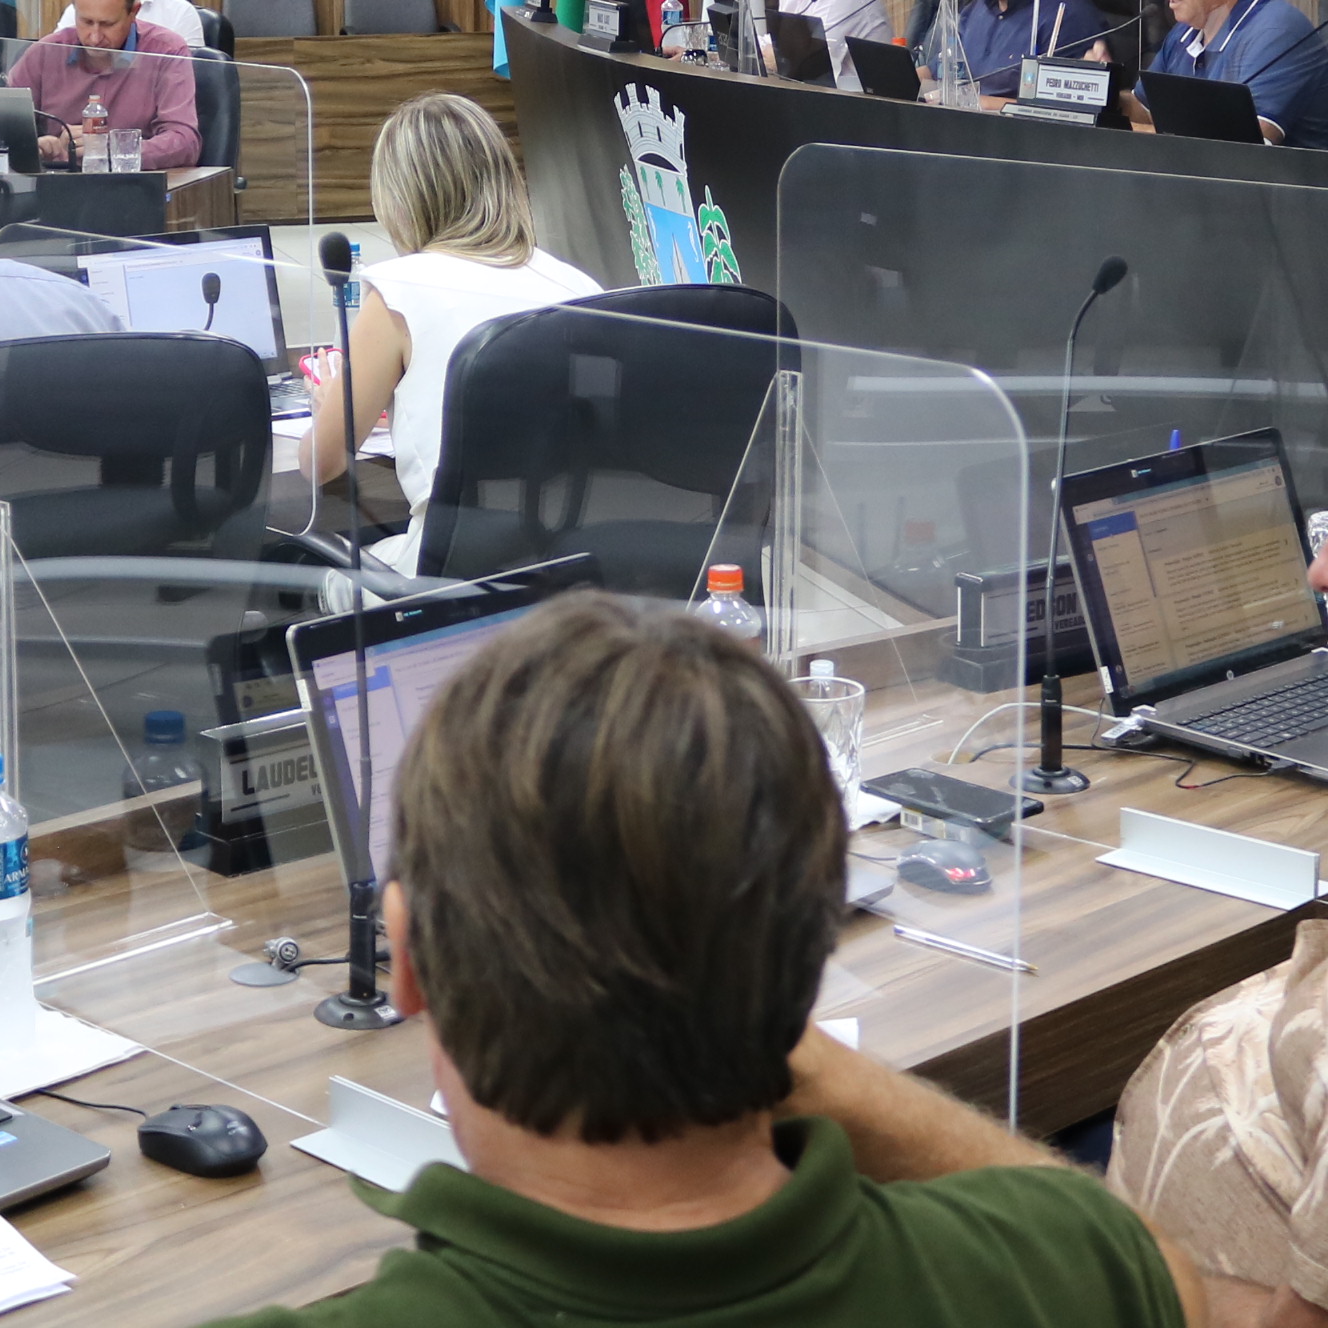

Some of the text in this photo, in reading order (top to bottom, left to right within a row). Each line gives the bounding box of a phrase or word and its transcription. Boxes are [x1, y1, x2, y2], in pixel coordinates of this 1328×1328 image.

[1045, 77, 1099, 92] PEDRO MAZZUCHETTI
[1027, 592, 1077, 622] EDON
